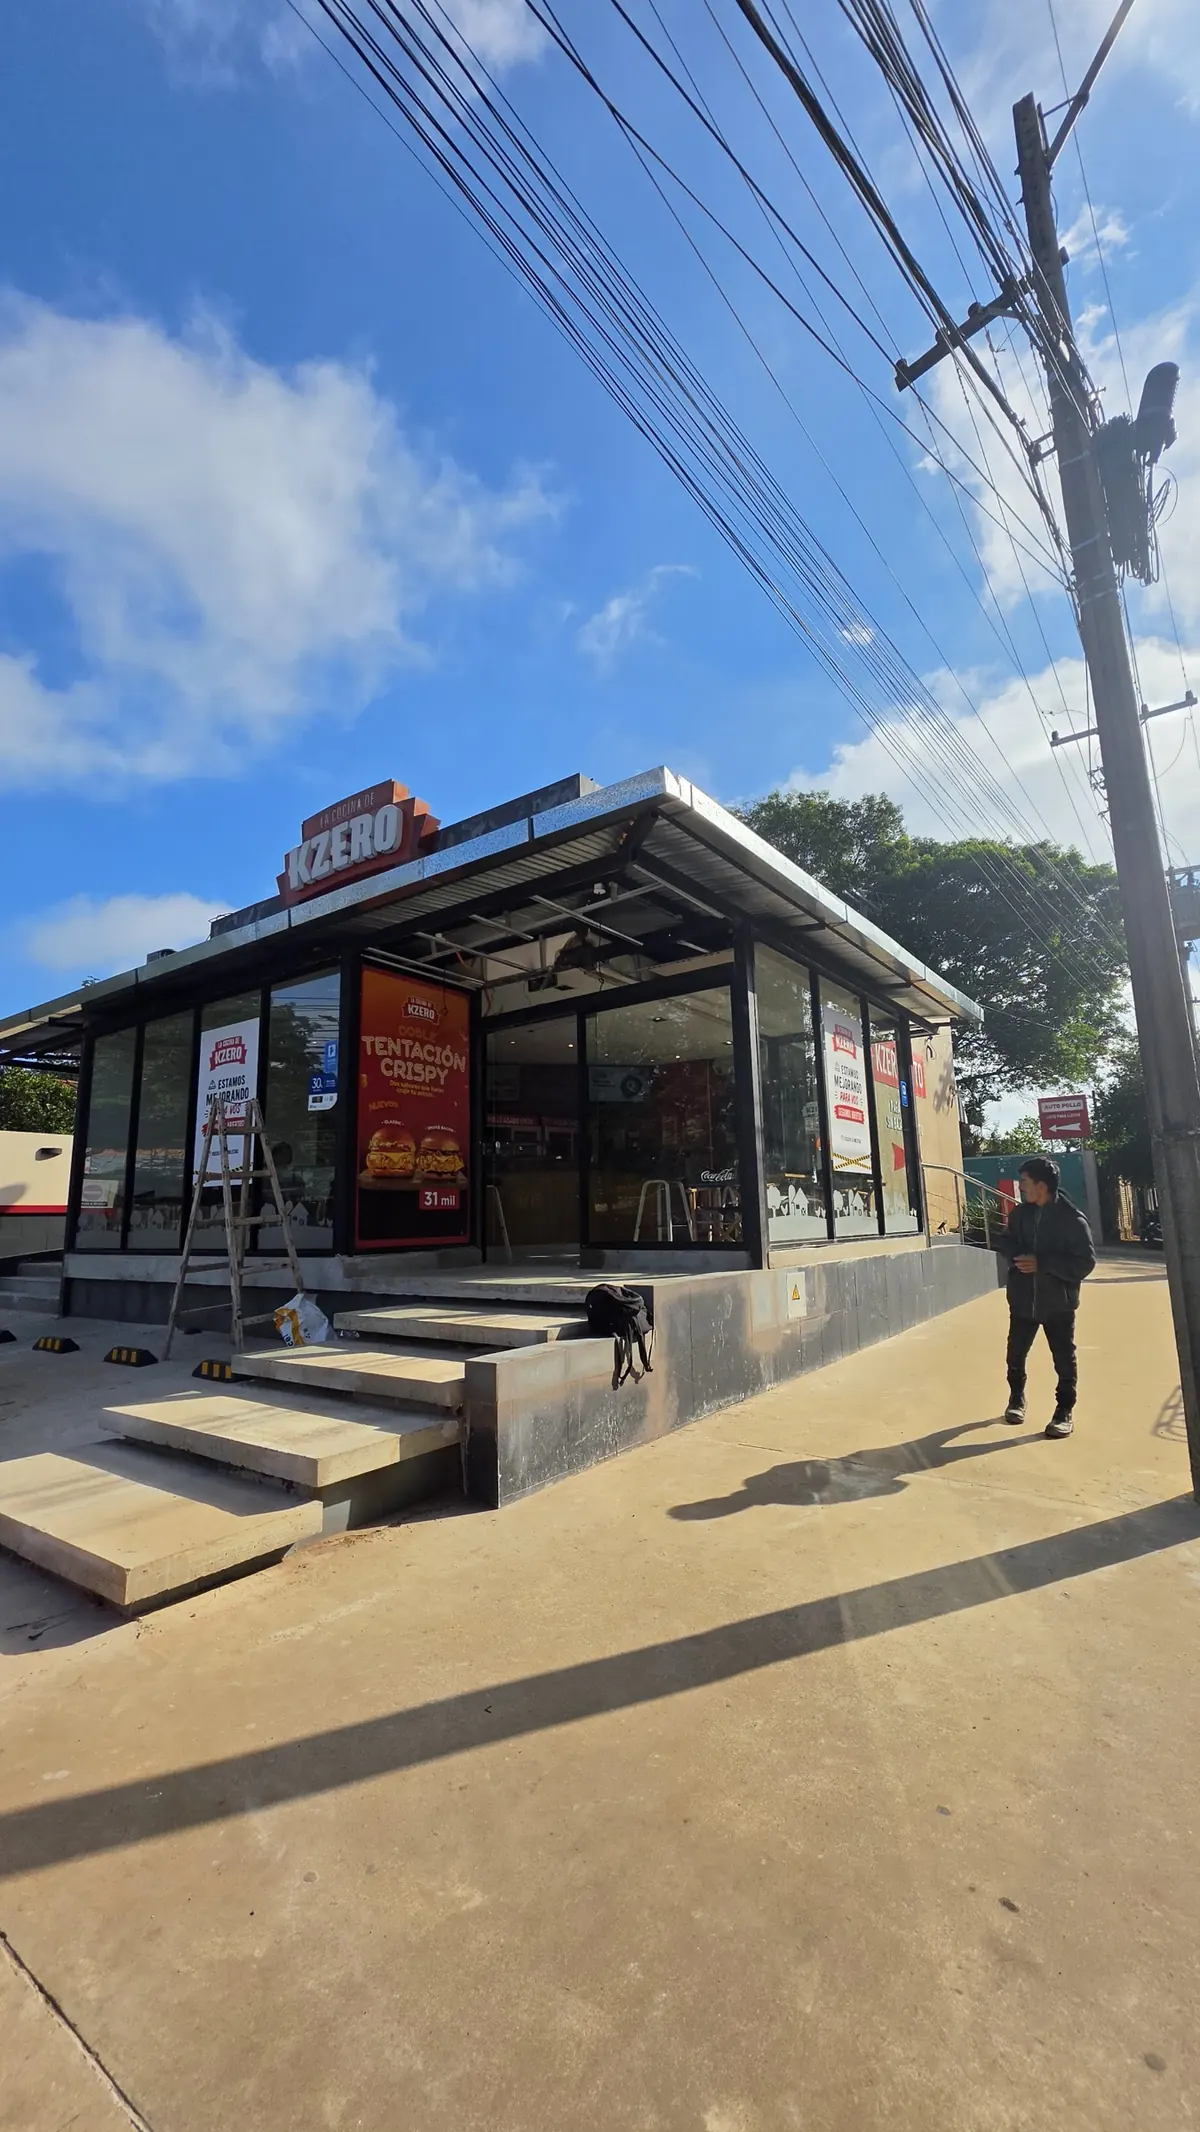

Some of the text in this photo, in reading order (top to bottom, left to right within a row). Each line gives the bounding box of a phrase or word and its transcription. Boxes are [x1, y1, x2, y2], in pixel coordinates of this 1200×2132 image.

[320, 791, 376, 829] LA COCINA DE
[288, 804, 404, 892] KZERO
[407, 1004, 435, 1019] KZERO
[398, 1025, 438, 1042] DOBLE
[214, 1046, 243, 1064] KZERO
[361, 1035, 466, 1072] TENTACIÓN
[380, 1057, 449, 1085] CRISPY
[218, 1074, 246, 1090] ESTAMOS
[834, 1074, 863, 1095] MEJORANDO
[424, 1191, 456, 1206] 31 mil
